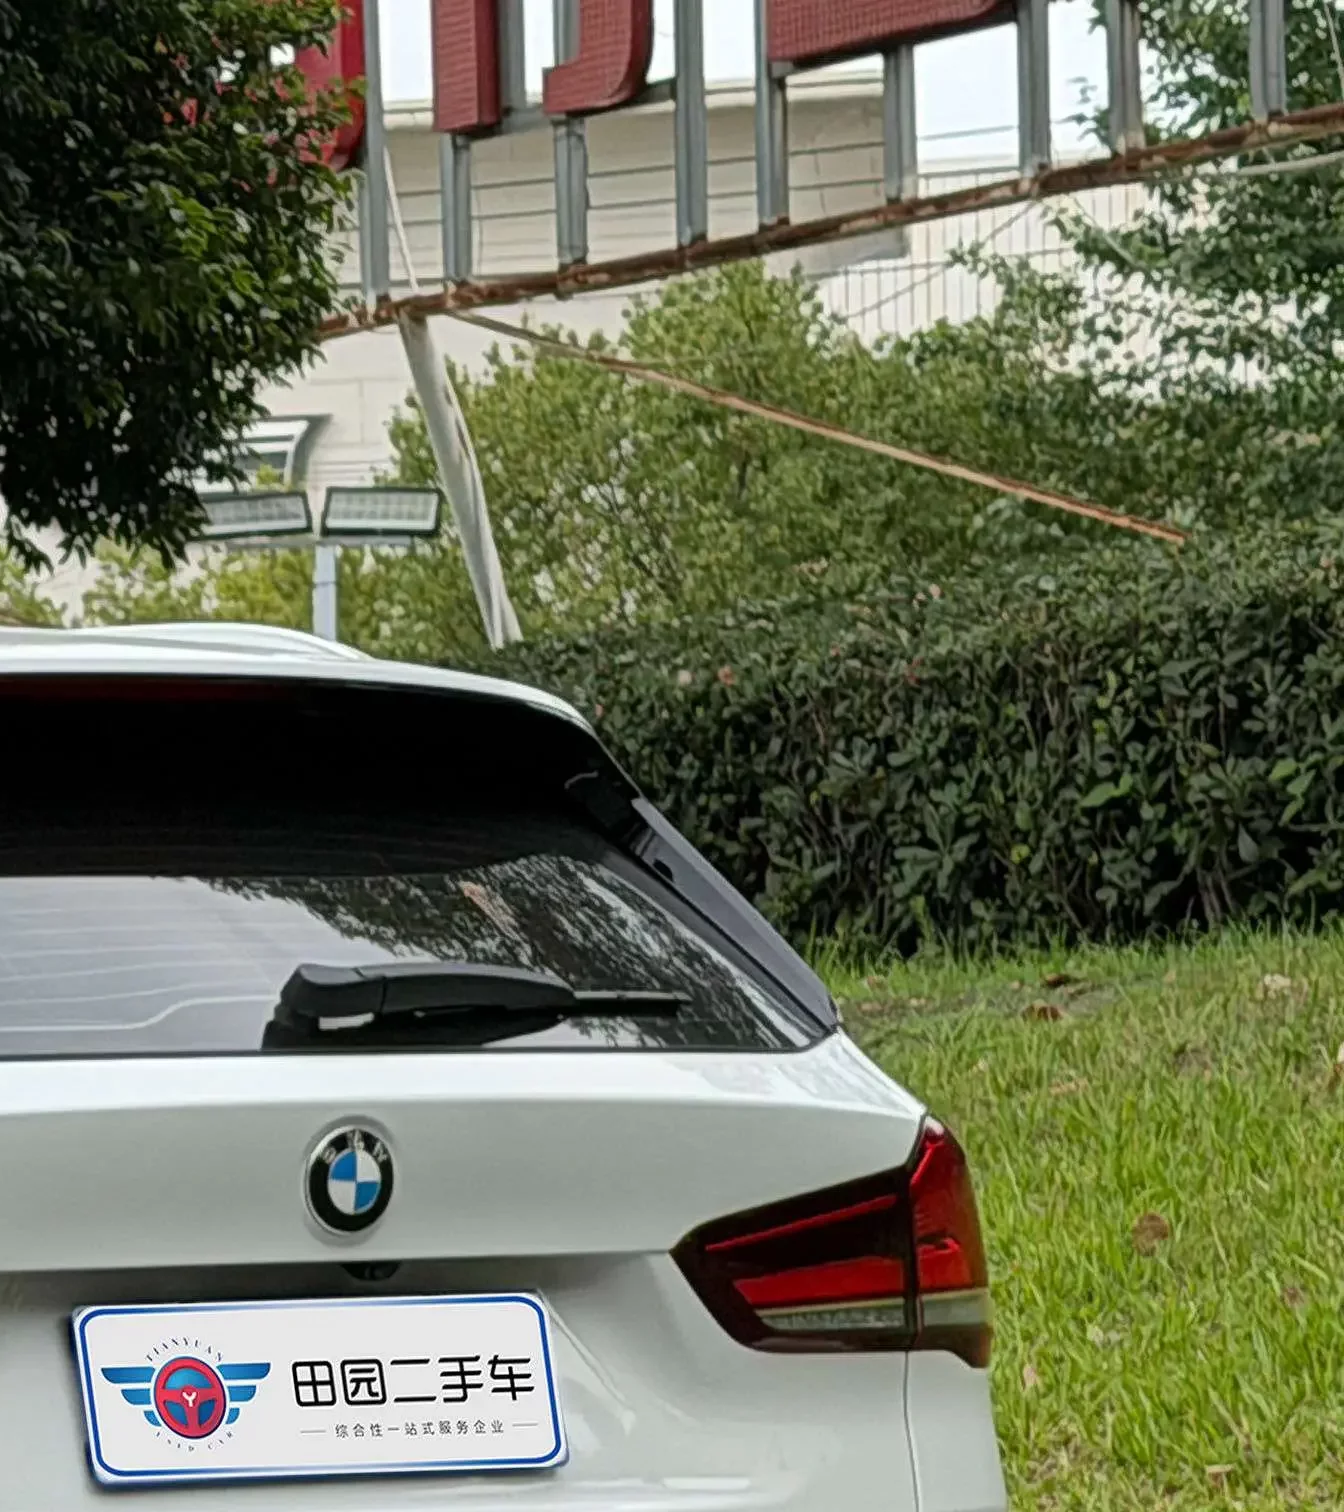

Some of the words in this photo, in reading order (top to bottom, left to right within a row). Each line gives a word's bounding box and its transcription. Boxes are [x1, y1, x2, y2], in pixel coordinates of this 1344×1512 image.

[291, 1354, 536, 1407] 田园二手车
[334, 1419, 505, 1439] 综合性一站式服务企业
